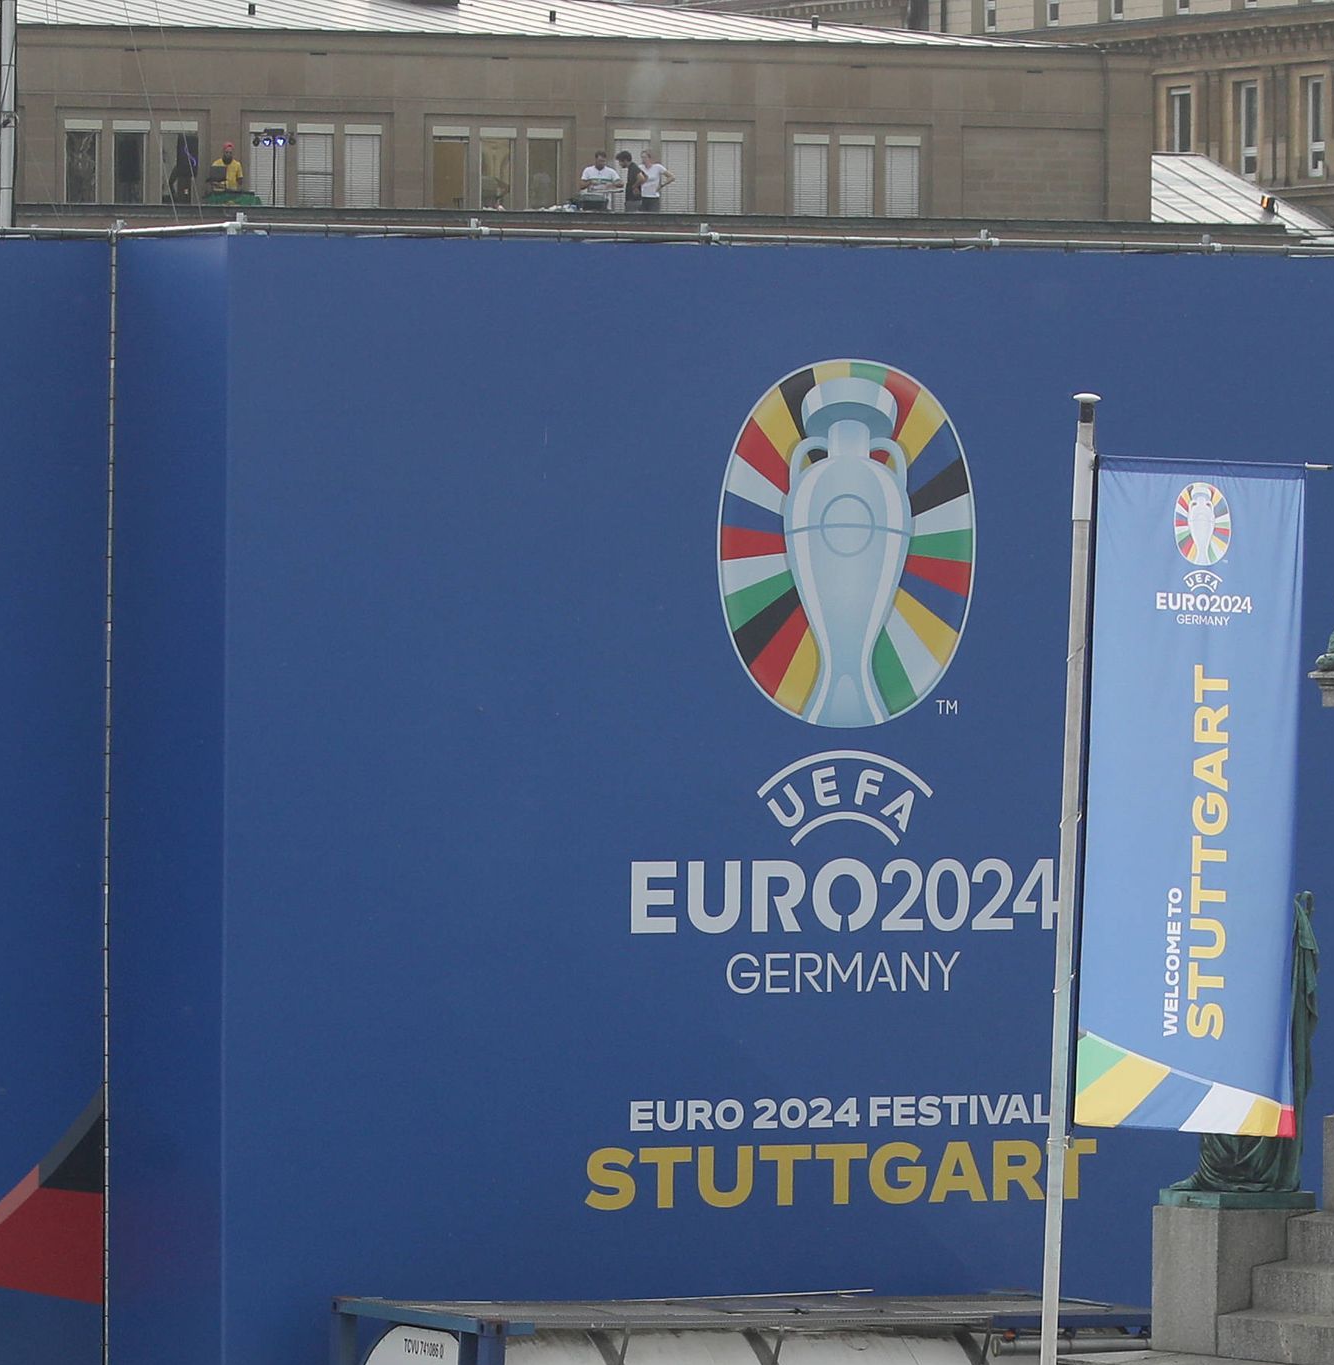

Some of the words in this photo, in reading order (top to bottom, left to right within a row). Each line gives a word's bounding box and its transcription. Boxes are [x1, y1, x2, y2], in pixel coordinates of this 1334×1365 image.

[1156, 592, 1252, 613] EURO2024
[1186, 574, 1218, 589] UEFA
[1177, 614, 1230, 626] GERMANY
[767, 766, 914, 832] UEFA
[1186, 664, 1229, 1040] STUTTGART
[630, 857, 1059, 934] EURO2024
[1167, 887, 1182, 917] TO
[727, 951, 960, 993] GERMANY
[1162, 922, 1182, 1036] WELCOME
[630, 1099, 744, 1132] EURO
[753, 1098, 860, 1129] 2024
[870, 1094, 1051, 1127] FESTIVAL
[585, 1139, 1096, 1210] STUTTGART
